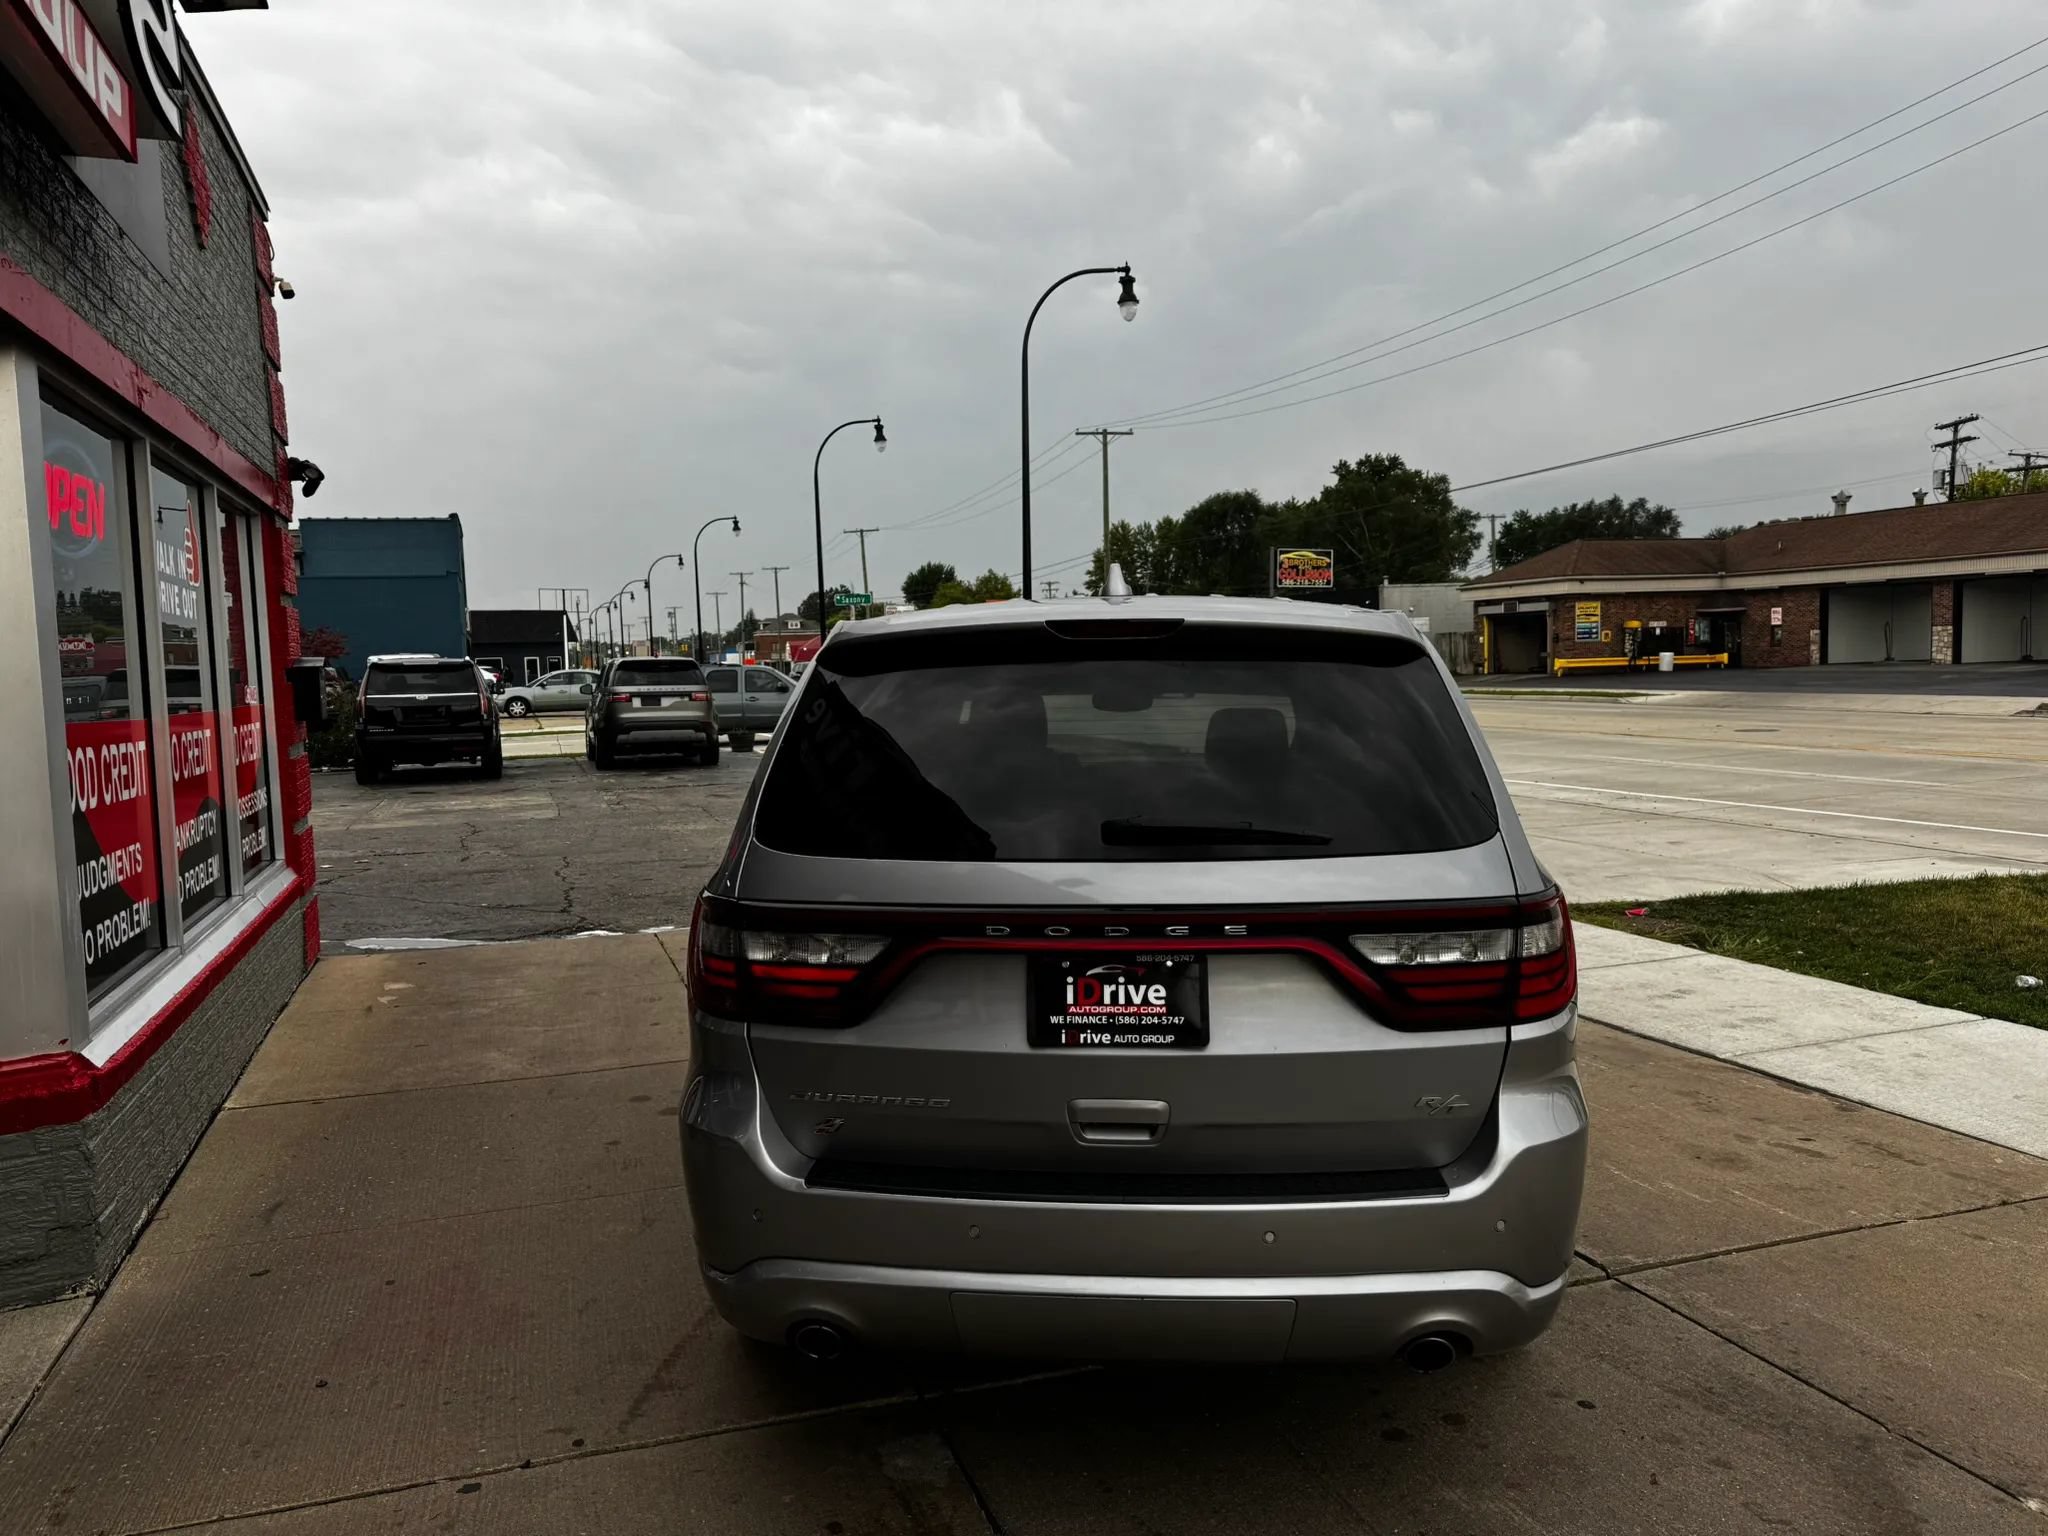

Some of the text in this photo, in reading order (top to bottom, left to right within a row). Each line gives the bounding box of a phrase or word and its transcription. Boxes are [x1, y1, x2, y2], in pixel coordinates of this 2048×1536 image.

[156, 540, 176, 577] ALK
[1288, 558, 1327, 566] BROTHERS
[160, 580, 198, 619] RIVE OUT
[171, 733, 180, 782] O
[181, 729, 212, 780] CREDIT
[239, 721, 261, 764] CREDIT
[100, 740, 147, 806] CREDIT
[176, 808, 217, 852] ANKRUPTCY
[82, 896, 152, 966] O PROBLEM!
[985, 925, 1249, 936] DODGE
[1066, 976, 1167, 1006] iDrive
[1050, 1015, 1185, 1026] WE FINANCE (586) 204-5747
[1068, 1006, 1167, 1014] AUTOGROUP.COM
[1061, 1029, 1175, 1044] iDrive AUTO GROUP
[1414, 1094, 1471, 1116] R/T
